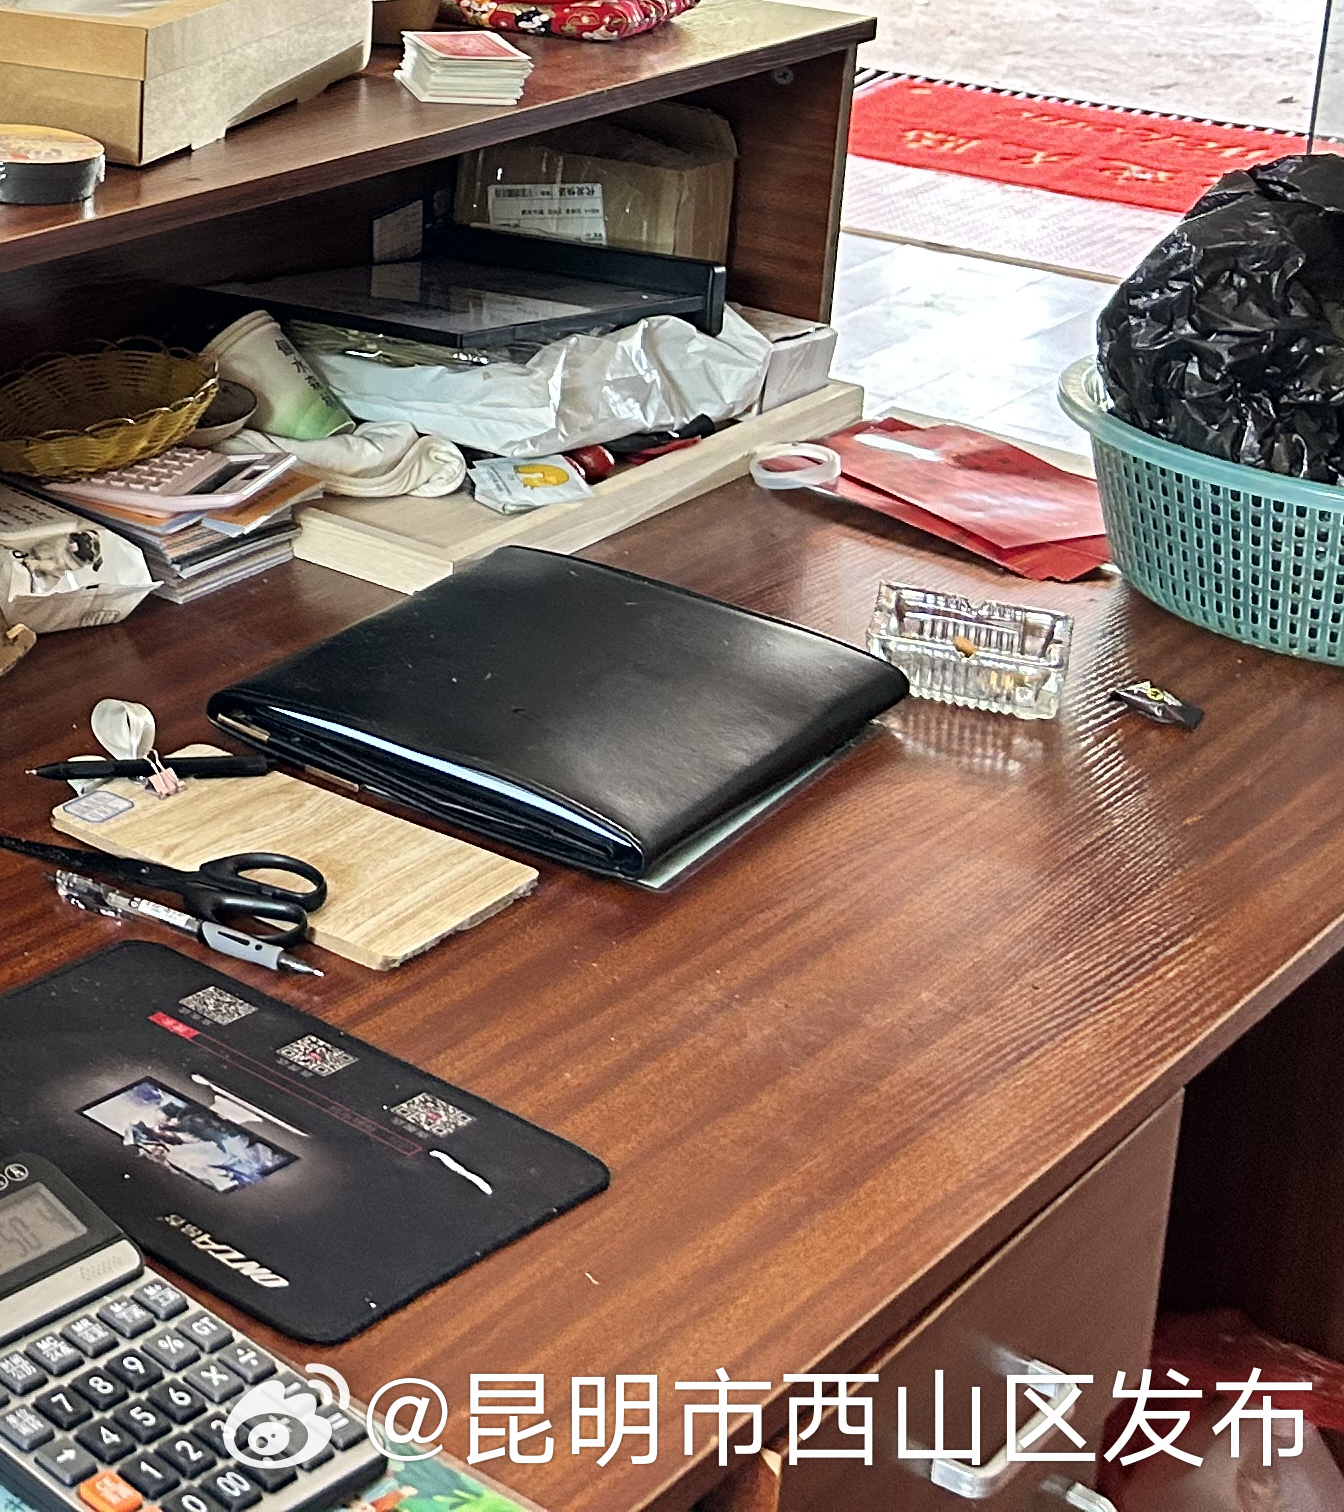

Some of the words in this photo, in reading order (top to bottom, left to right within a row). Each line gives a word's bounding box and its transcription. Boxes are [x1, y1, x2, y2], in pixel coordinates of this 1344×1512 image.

[191, 1316, 219, 1337] GT
[121, 1356, 147, 1376] 9
[87, 1375, 114, 1395] 8
[50, 1392, 74, 1413] 7
[167, 1387, 192, 1407] 6
[129, 1406, 157, 1428] 5
[99, 1424, 121, 1446] 4
[175, 1439, 203, 1461] 2
[139, 1460, 163, 1479] 1
[216, 1471, 250, 1498] 00
